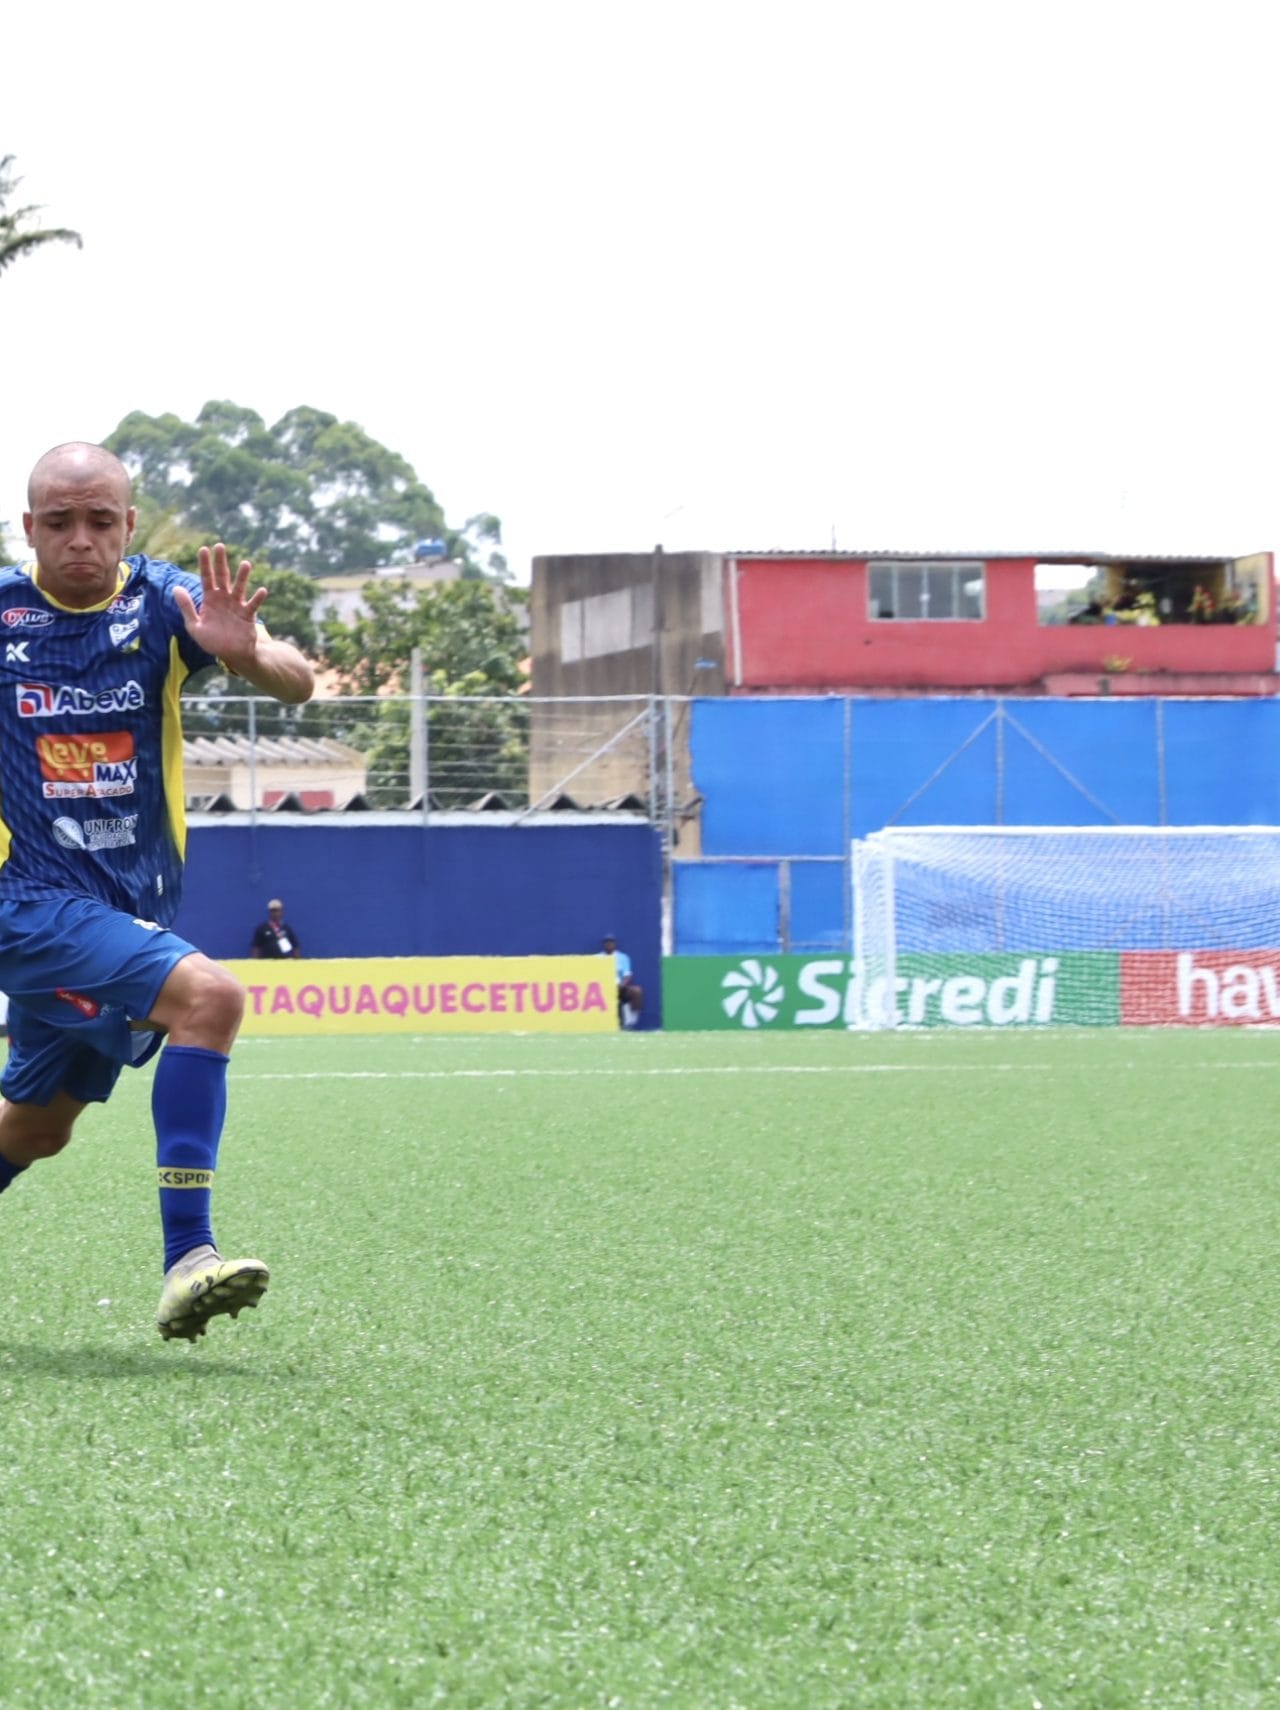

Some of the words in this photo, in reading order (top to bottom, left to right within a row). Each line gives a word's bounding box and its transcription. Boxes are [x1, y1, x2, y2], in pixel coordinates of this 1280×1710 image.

[55, 683, 142, 713] Abevê
[96, 760, 134, 785] MAX
[248, 982, 608, 1017] TAQUAQUECETUBA
